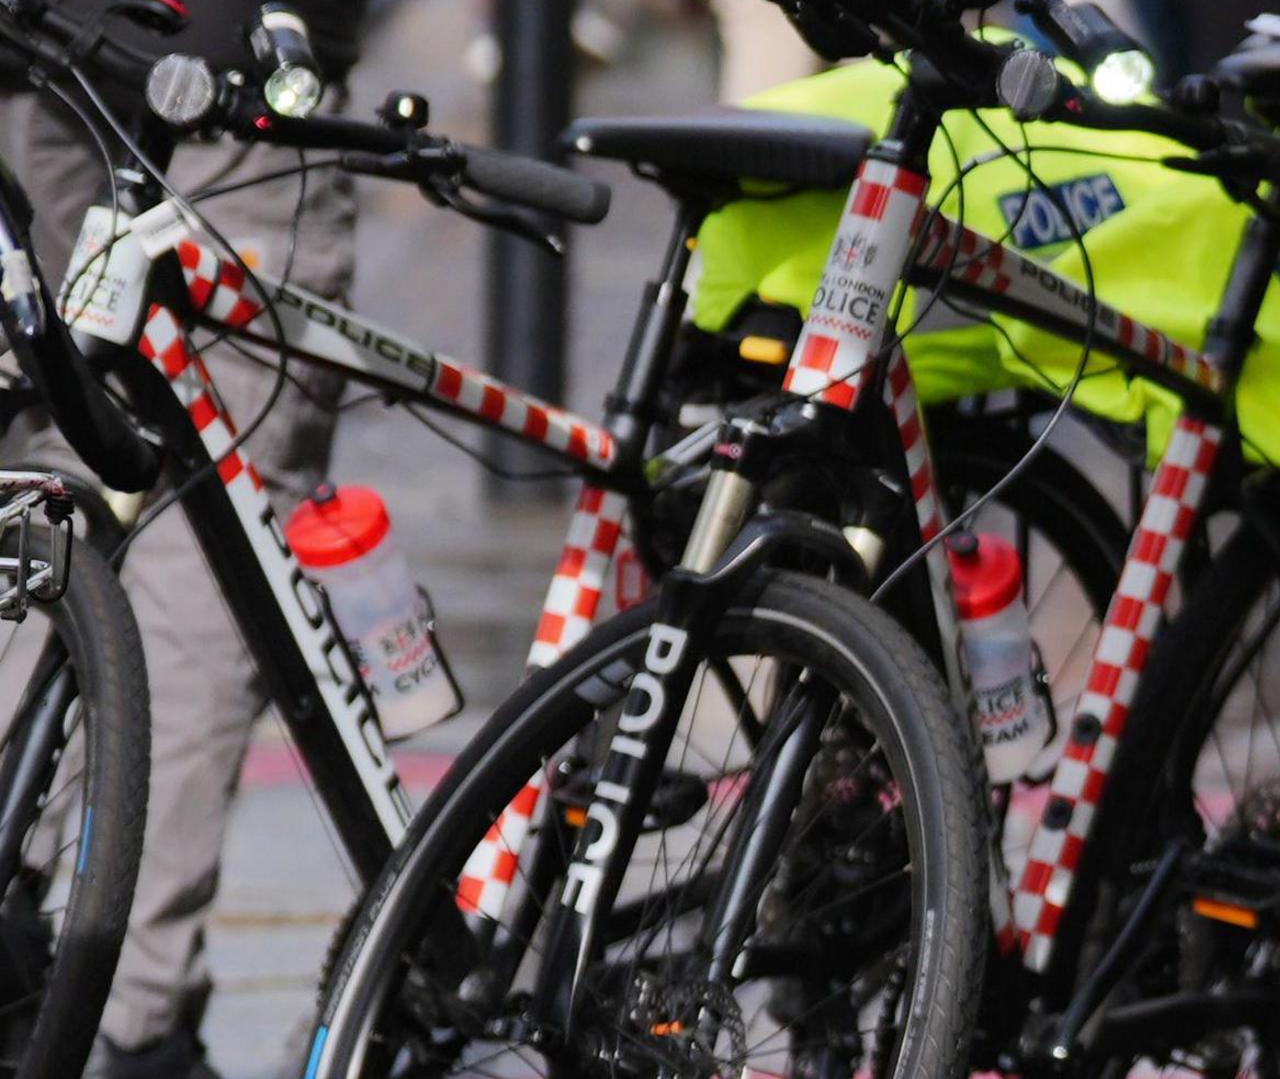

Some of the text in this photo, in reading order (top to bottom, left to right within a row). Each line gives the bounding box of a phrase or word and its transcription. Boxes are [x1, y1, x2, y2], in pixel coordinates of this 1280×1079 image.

[1002, 172, 1119, 248] POLICE
[275, 287, 436, 380] POLICE
[812, 286, 882, 326] OLICE
[260, 506, 414, 828] POLICE
[560, 622, 688, 915] POLICE
